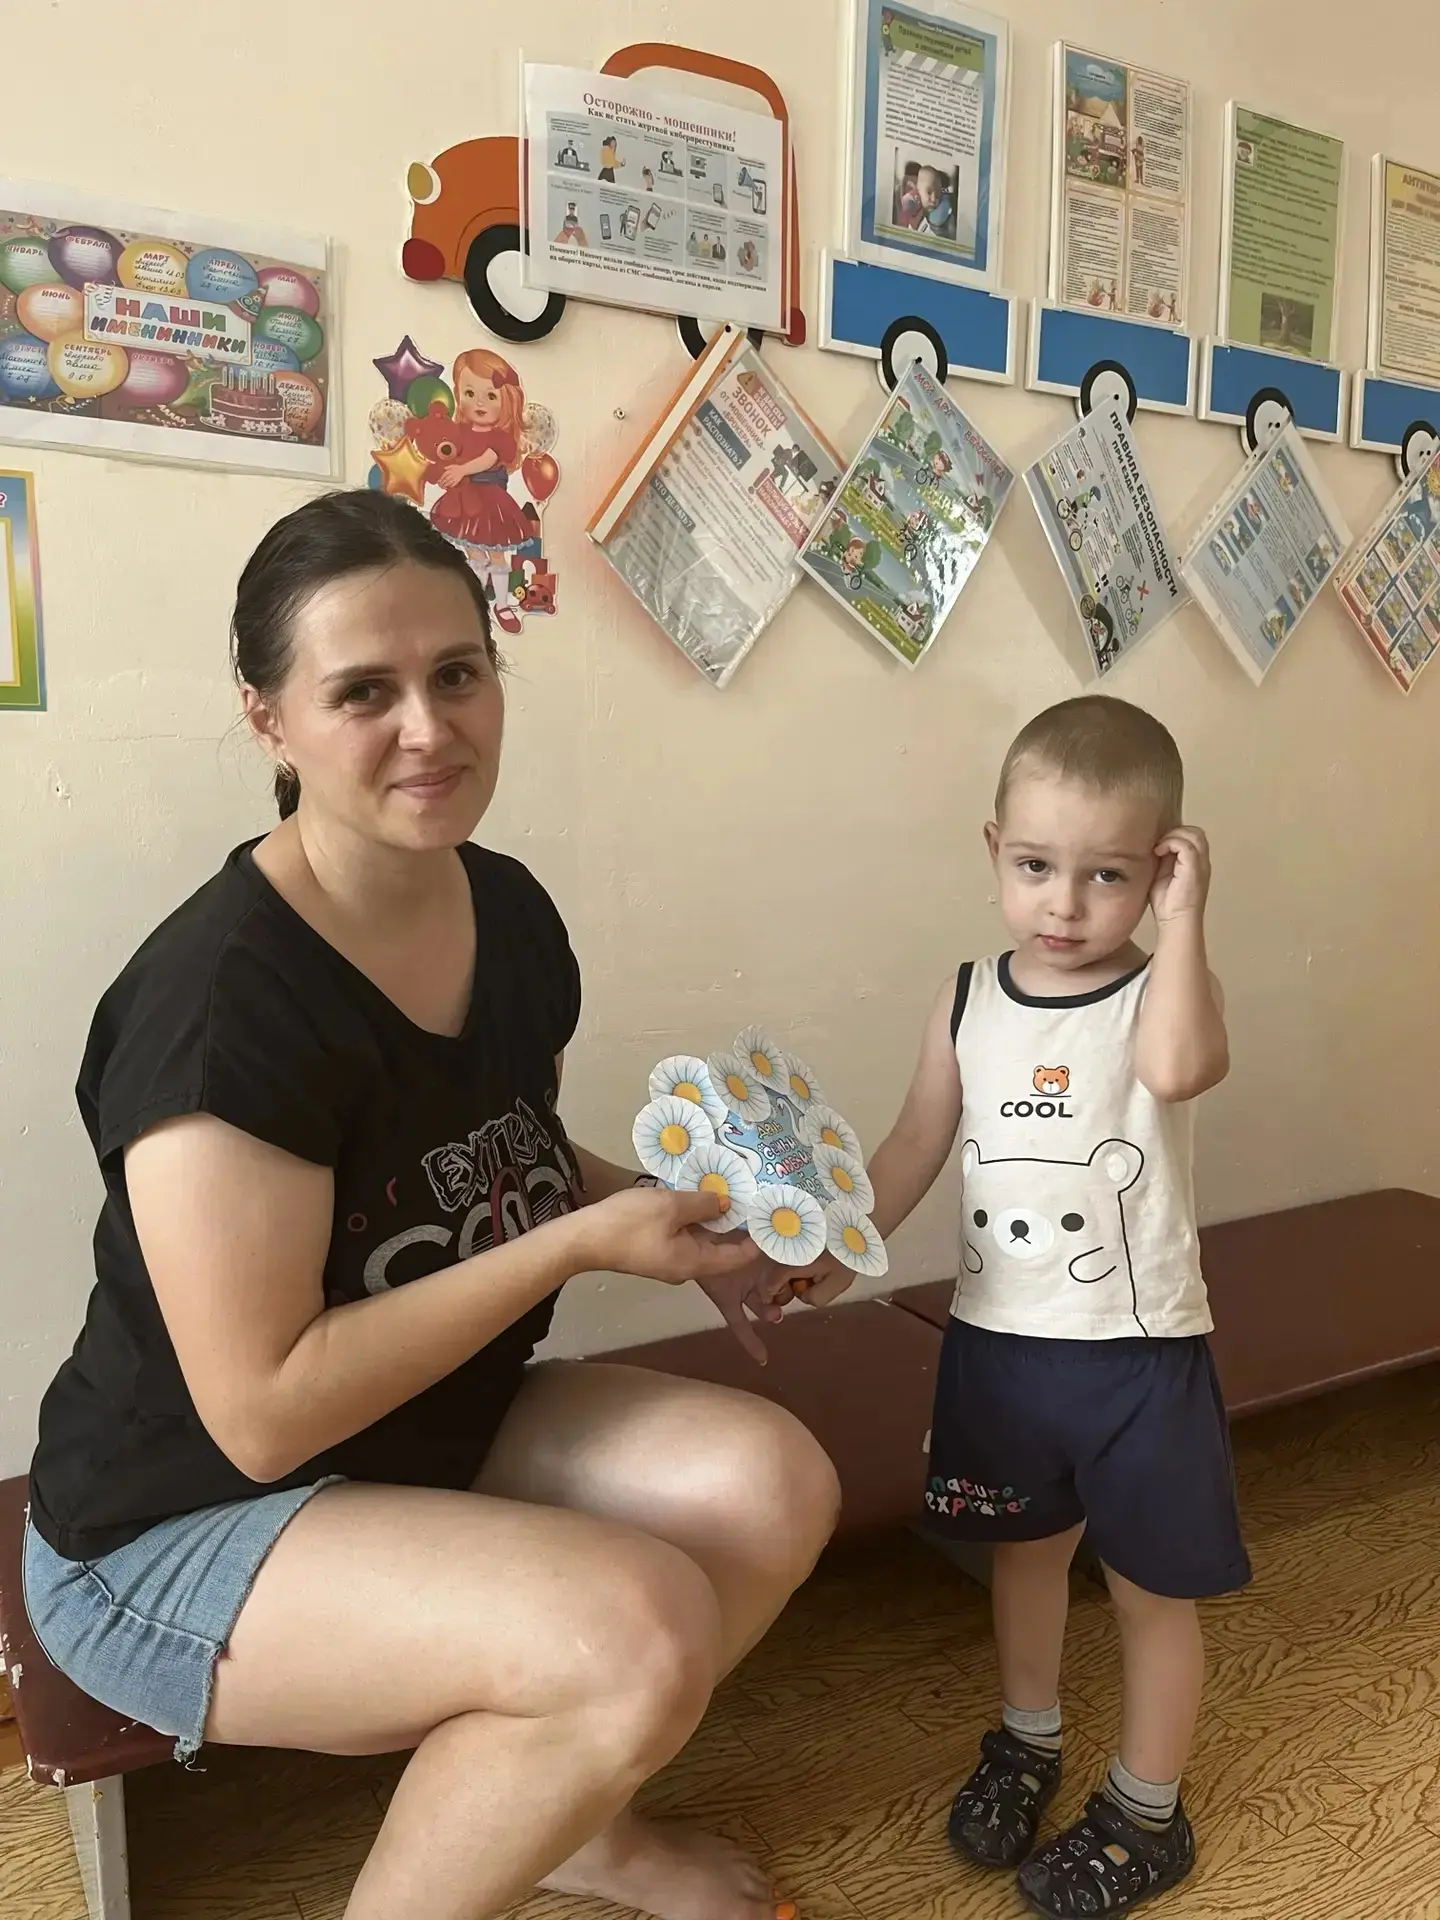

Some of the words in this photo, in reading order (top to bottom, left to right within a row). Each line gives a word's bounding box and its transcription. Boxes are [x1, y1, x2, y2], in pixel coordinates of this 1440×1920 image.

[583, 92, 653, 121] Осторожно
[664, 115, 737, 143] мошенники!
[588, 107, 604, 118] Как
[605, 112, 615, 121] не
[616, 114, 636, 127] стать
[638, 121, 669, 136] жертвой
[670, 129, 735, 152] киберпреступника
[7, 245, 44, 257] ЯНВАРЬ
[65, 235, 112, 250] ФЕВРАЛЬ
[143, 252, 170, 262] МАРТ
[208, 259, 241, 272] АПРЕЛЬ
[277, 274, 297, 284] МАЙ
[41, 289, 72, 300] ИЮНЬ
[115, 297, 227, 333] НАШИ
[91, 316, 246, 354] ИМЕНИННИКИ
[64, 343, 113, 356] СЕНТЯБРЬ
[719, 391, 731, 403] ОТ
[708, 409, 722, 426] КАК
[732, 387, 772, 439] ЗВОНОК
[914, 373, 936, 396] МОЙ
[933, 397, 956, 417] ДРУГ
[964, 430, 1006, 481] ВЕЛОСИПЕД
[702, 415, 743, 468] РАСПОЗНАТЬ?
[655, 479, 667, 496] ЧТО
[664, 494, 693, 528] ДЕЛАТЬ?
[1109, 411, 1140, 484] ПРАВИЛА
[1136, 484, 1179, 597] БЕЗОПАСНОСТИ
[1111, 440, 1124, 464] ПРИ
[1121, 465, 1135, 494] ЕЗДЕ
[1131, 496, 1140, 512] НА
[1137, 512, 1163, 582] ВЕЛОСИПЕДЕ
[1000, 1101, 1073, 1118] COOL
